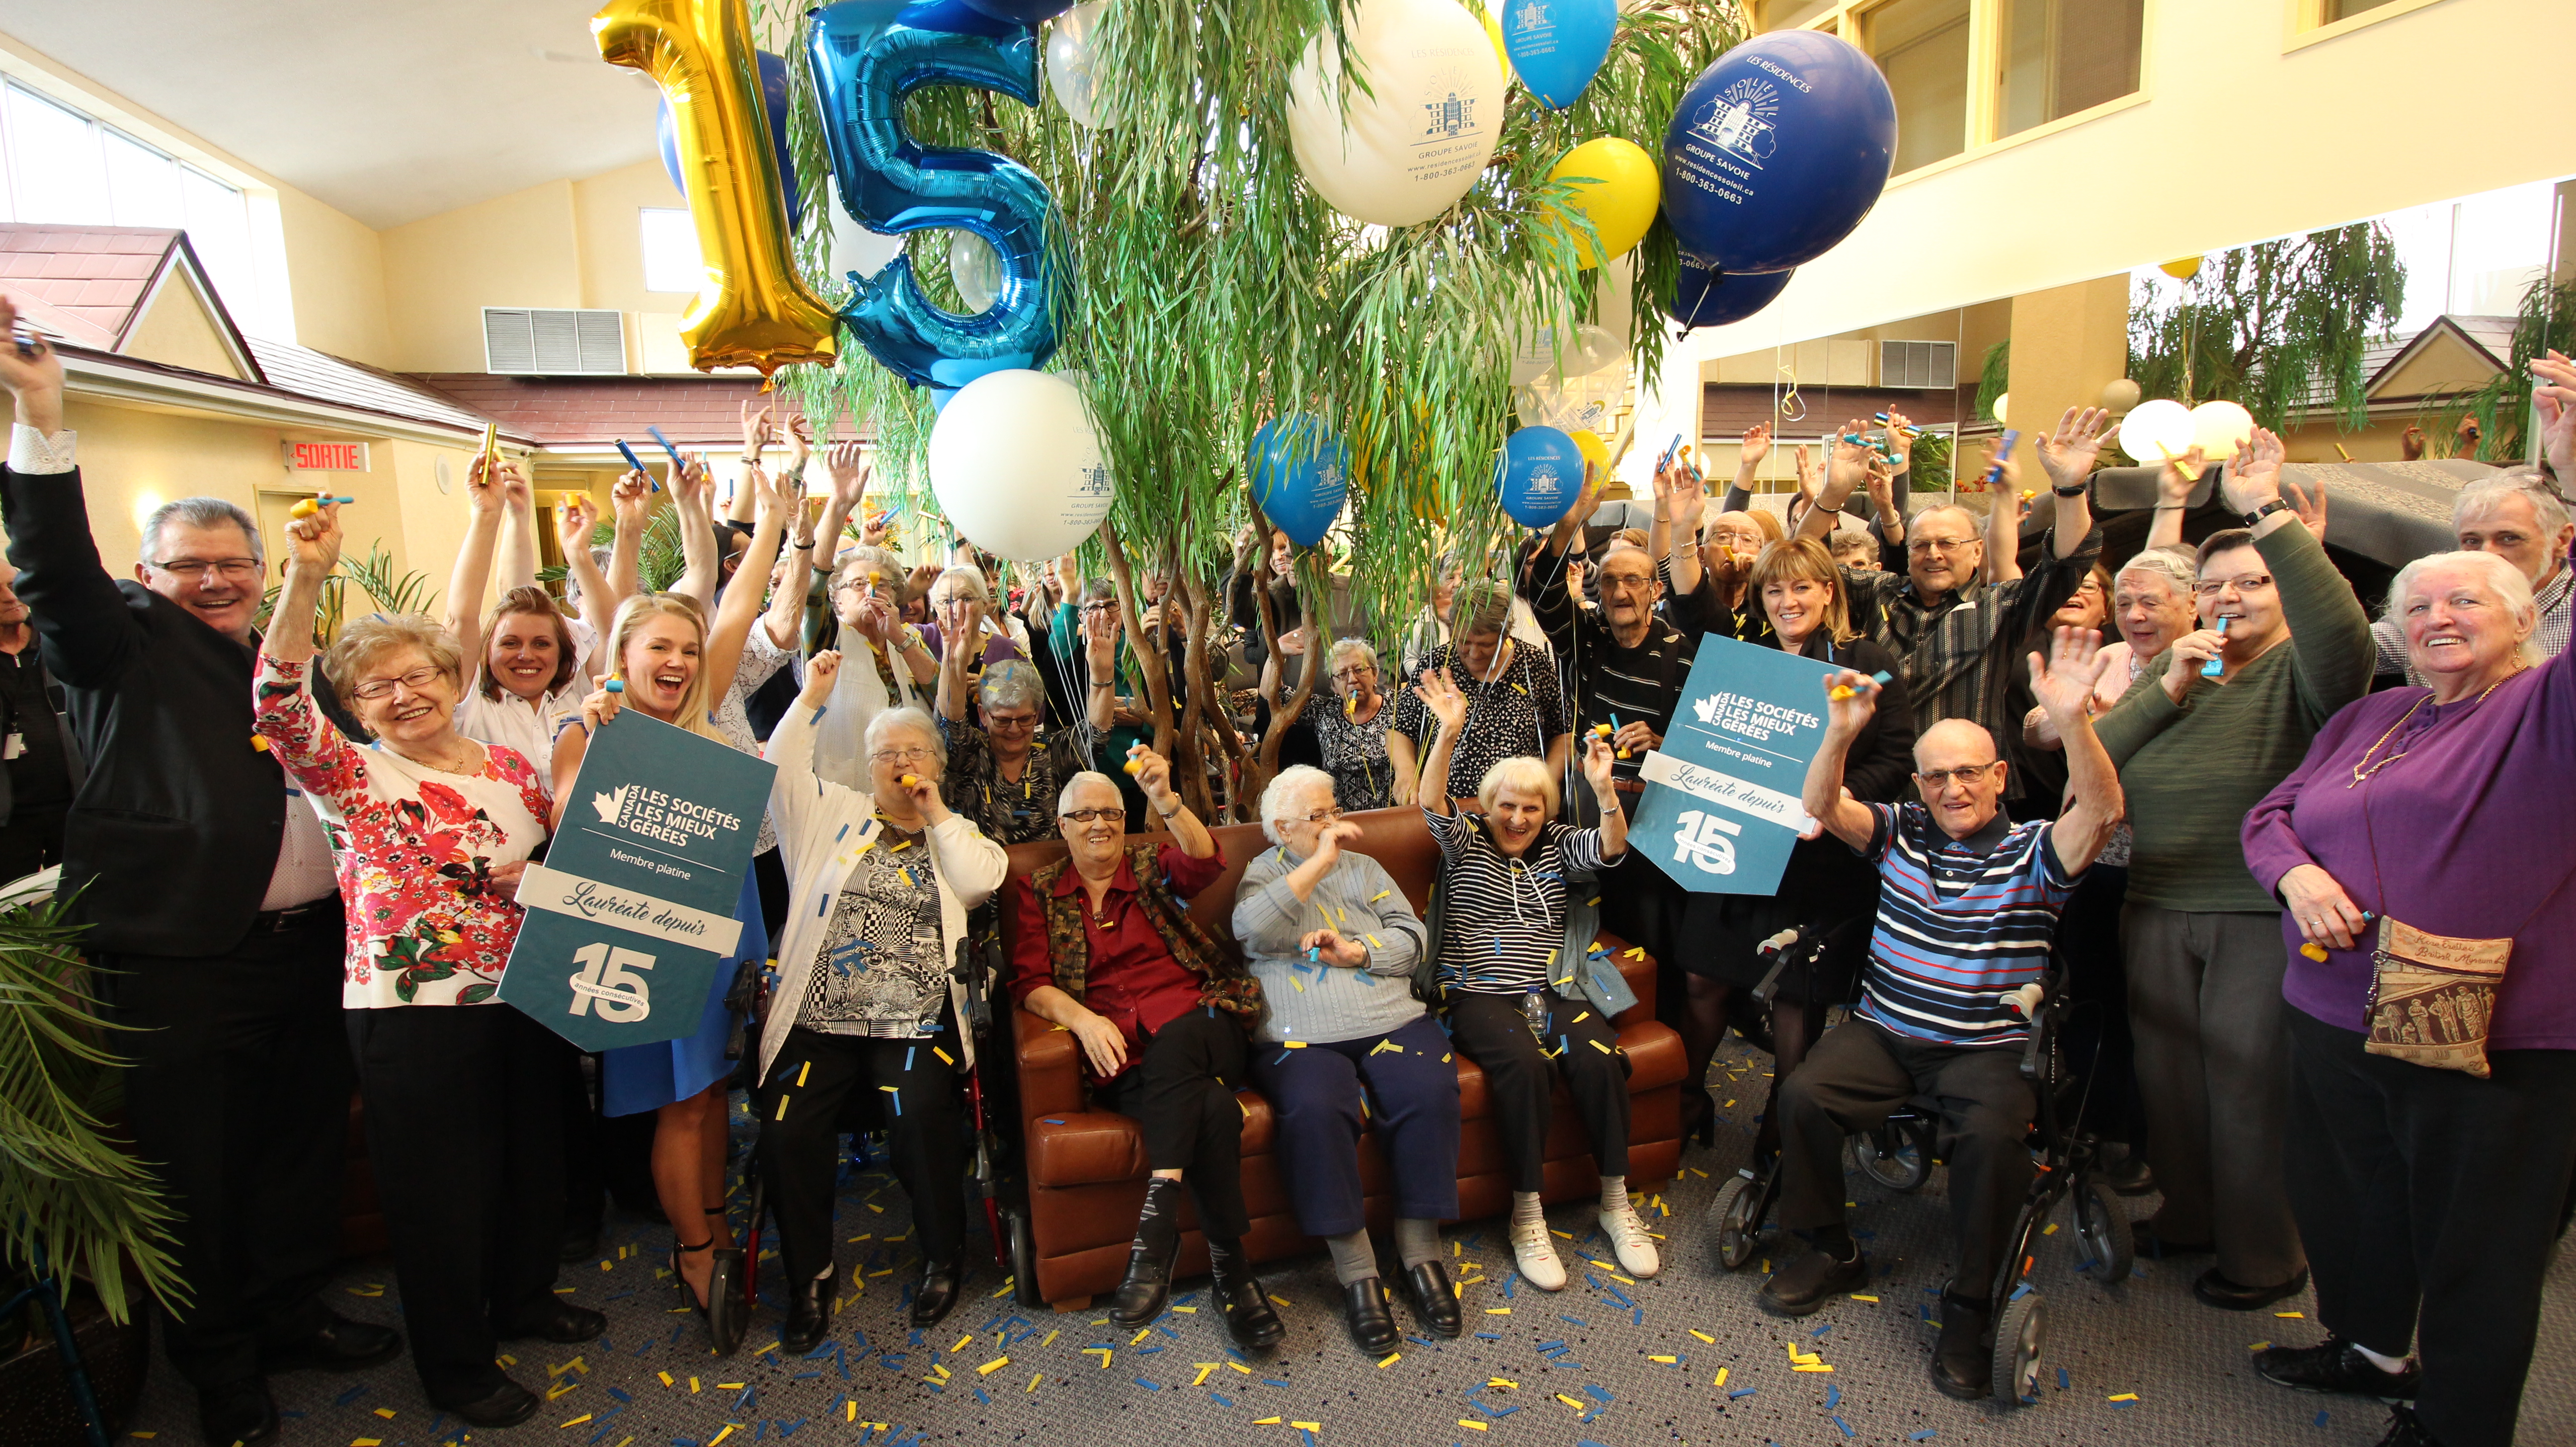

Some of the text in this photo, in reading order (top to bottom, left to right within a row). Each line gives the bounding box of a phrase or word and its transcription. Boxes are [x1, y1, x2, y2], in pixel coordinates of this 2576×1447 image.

[1411, 46, 1475, 59] LES RÉSIDENCES
[1424, 66, 1474, 97] SOLEIL
[1746, 55, 1812, 93] LES RÉSIDENCES
[1724, 78, 1779, 118] SOLEIL
[1407, 150, 1481, 172] www.residencessoleil.ca
[1418, 141, 1478, 159] GROUPE SAVOIE
[1686, 144, 1750, 180] GROUPE SAVOIE
[1414, 161, 1475, 182] 1-800-363-0663
[1675, 155, 1754, 196] www.residencessoleil.ca
[1676, 167, 1742, 205] 1-800-363-0663
[295, 444, 359, 469] SORTIE
[1712, 692, 1731, 725] CANADA
[1725, 705, 1796, 736] LES MIEUX
[1729, 694, 1820, 729] LES SOCIÉTÉS
[1721, 718, 1770, 741] GÉRÉES
[1705, 740, 1772, 768] Membre platine
[1670, 764, 1786, 813] Lauréate depuis
[619, 784, 641, 828] CANADA
[635, 802, 717, 840] LES MIEUX
[640, 787, 741, 831] LES SOCIÉTÉS
[630, 818, 688, 847] GÉRÉES
[1673, 809, 1742, 875] 15
[610, 848, 691, 881] Membre platine
[1678, 837, 1732, 864] années consécutives
[563, 882, 707, 936] Lauréate depuis
[2415, 947, 2450, 961] British
[2455, 953, 2493, 968] Museum
[568, 942, 658, 1024] 15
[574, 981, 645, 1007] années consécutives
